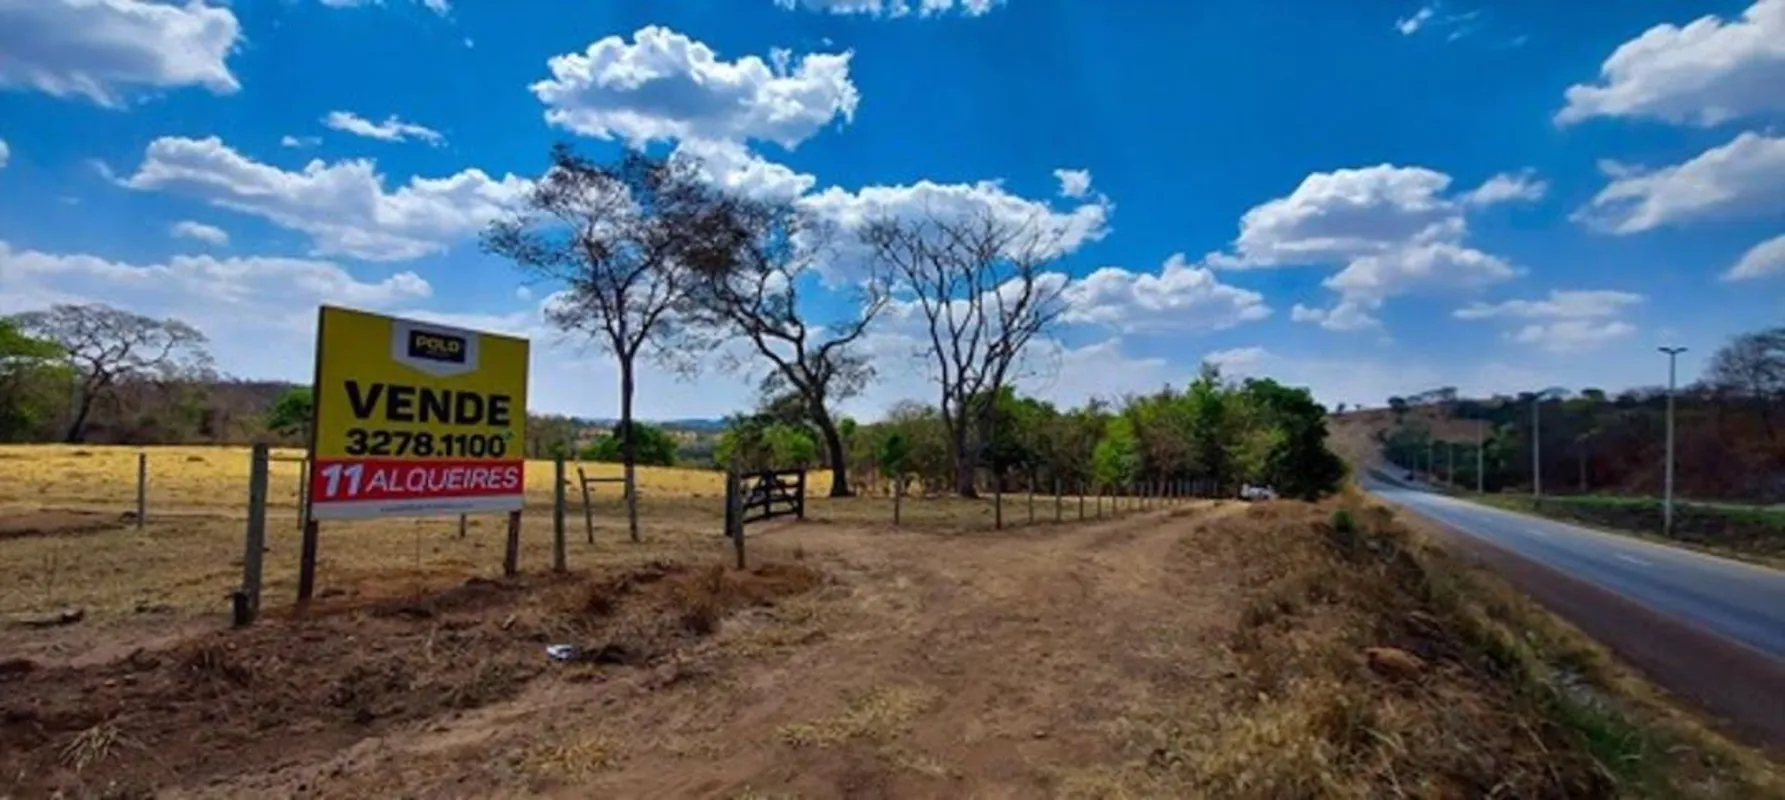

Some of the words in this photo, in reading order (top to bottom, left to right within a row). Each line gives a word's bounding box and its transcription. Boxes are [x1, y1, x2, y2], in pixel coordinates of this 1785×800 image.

[344, 380, 511, 426] VENDE
[345, 428, 506, 457] 3278.1100
[321, 463, 364, 496] 11
[366, 466, 518, 492] ALQUEIRES
